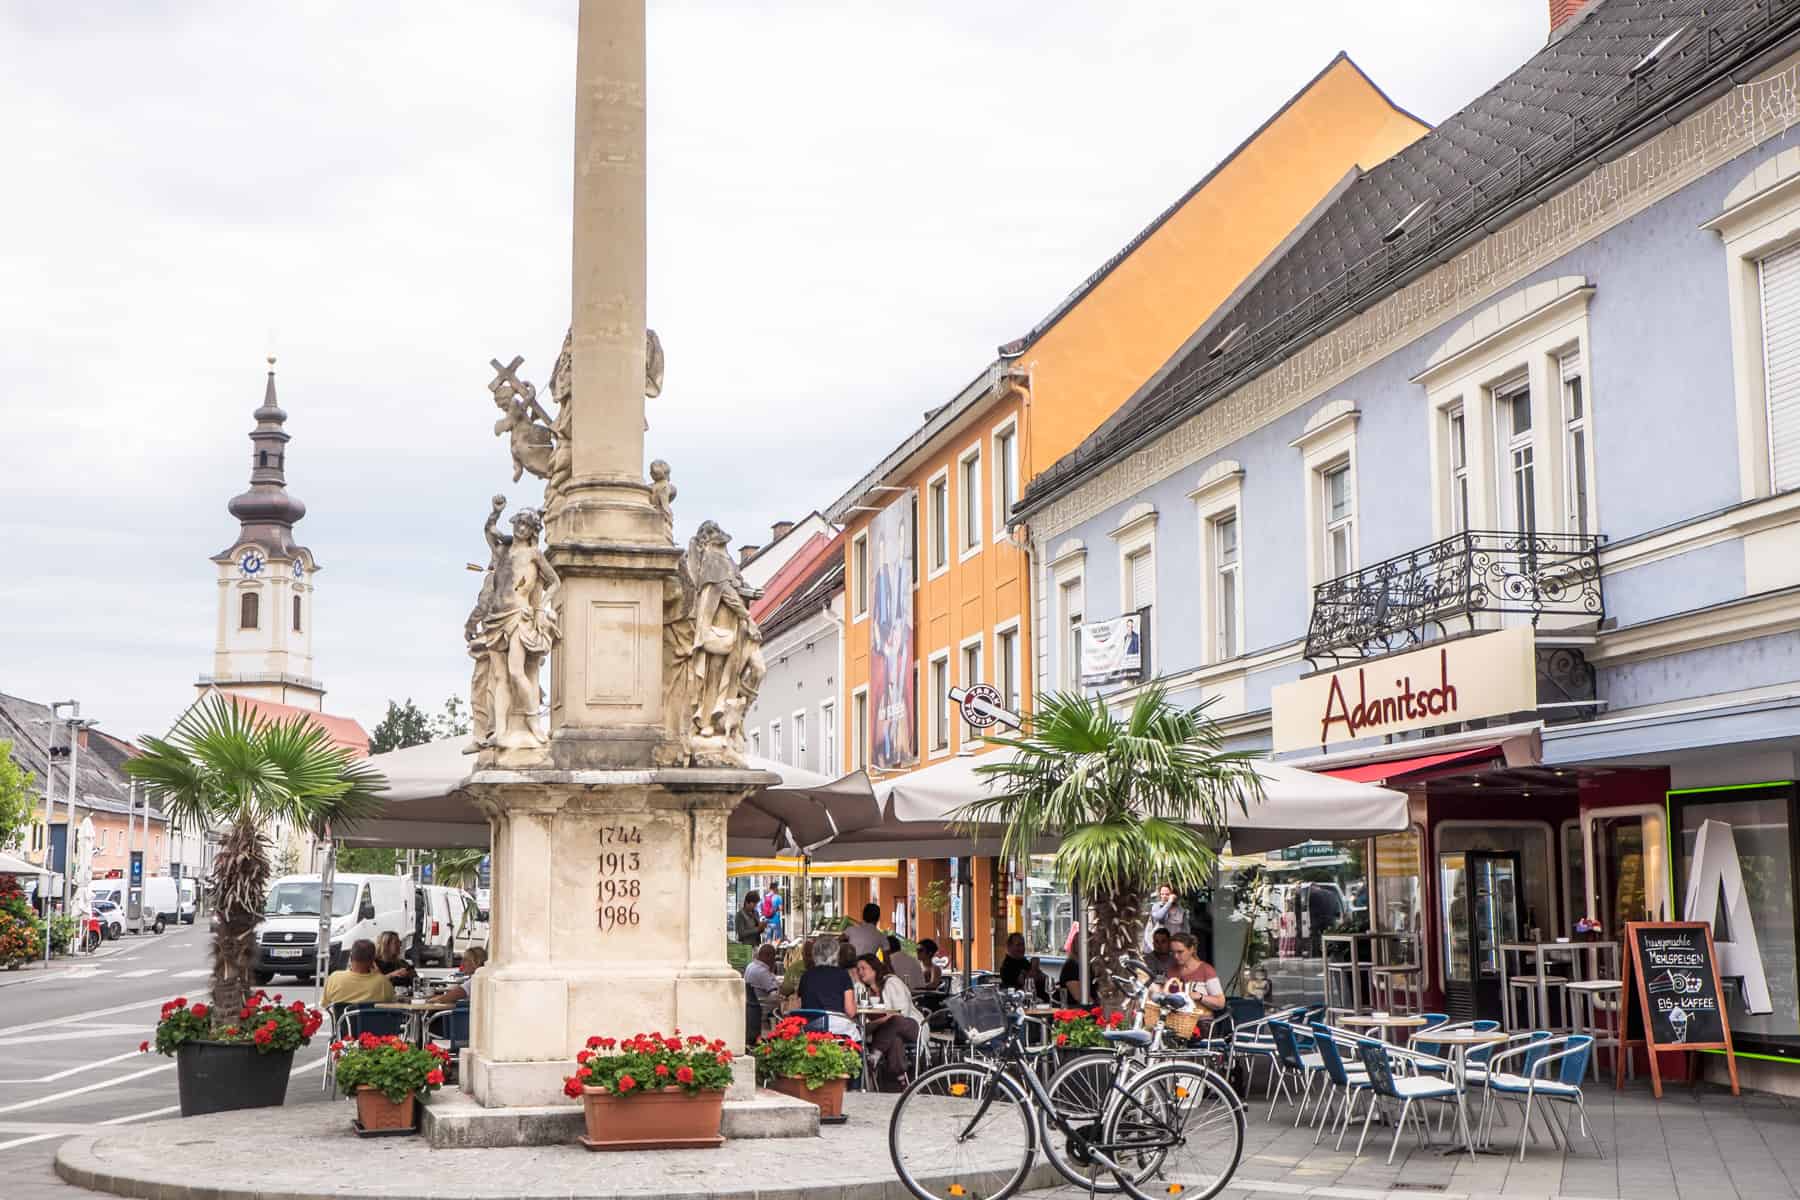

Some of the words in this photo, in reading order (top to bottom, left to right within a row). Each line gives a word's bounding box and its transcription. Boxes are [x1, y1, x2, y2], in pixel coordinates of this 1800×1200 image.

[970, 688, 1001, 704] TABAK
[1321, 648, 1457, 743] Adanitsch
[964, 703, 993, 725] TRAFIK
[599, 826, 642, 848] 1744
[598, 852, 640, 876] 1913
[597, 879, 641, 903] 1938
[596, 902, 640, 936] 1986
